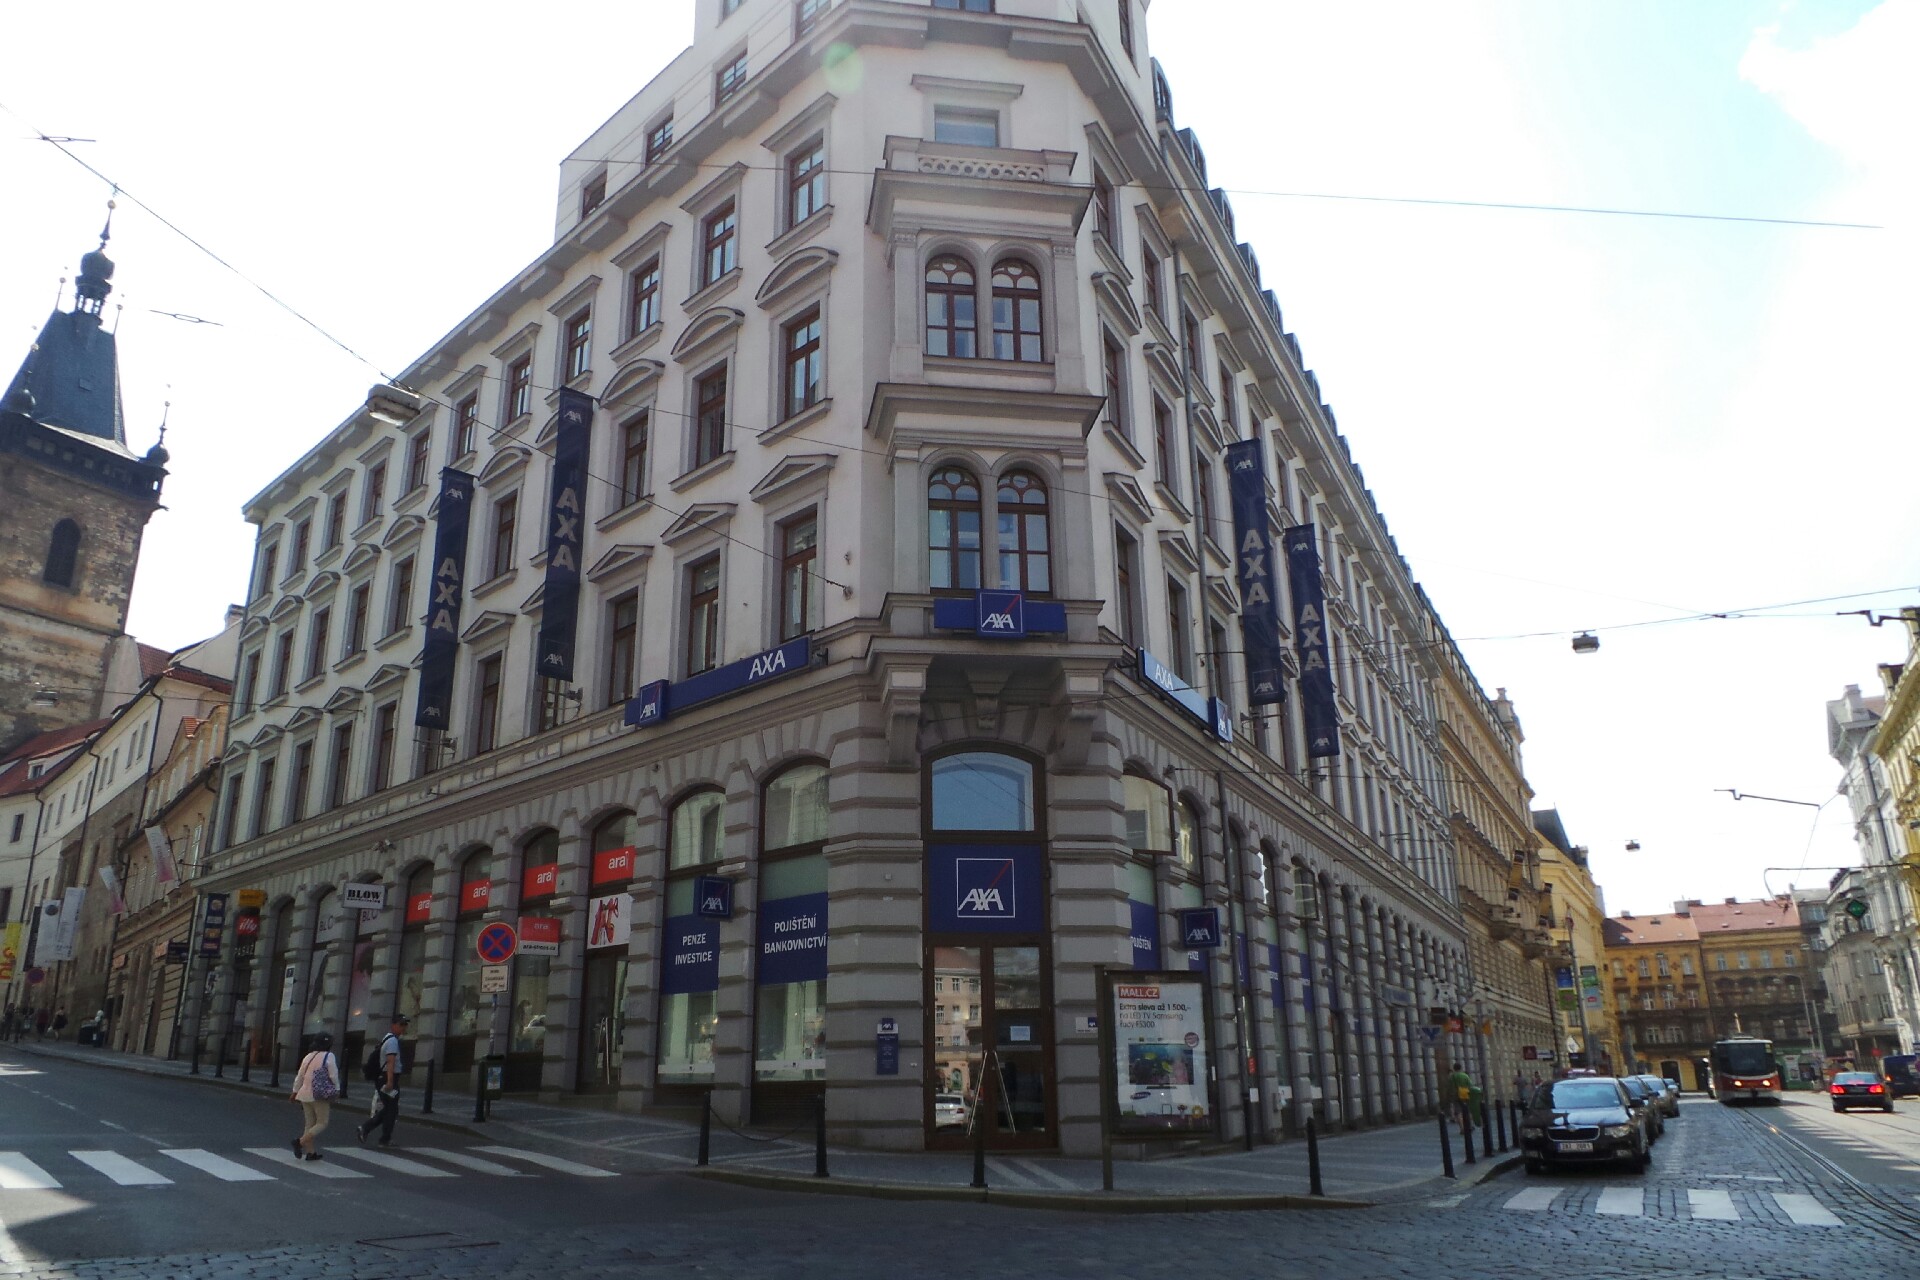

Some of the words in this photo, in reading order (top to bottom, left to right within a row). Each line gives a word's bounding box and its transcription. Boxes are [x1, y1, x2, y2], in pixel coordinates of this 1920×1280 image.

[564, 409, 582, 424] AXA
[1234, 458, 1254, 472] AXA
[446, 486, 464, 500] AXA
[551, 487, 581, 572] AXA
[1291, 541, 1309, 553] AXA
[1241, 529, 1270, 606] AXA
[432, 557, 460, 634] AXA
[981, 613, 1015, 630] AXA
[1299, 604, 1326, 671] AXA
[543, 652, 564, 666] AXA
[749, 649, 786, 681] AXA
[1155, 663, 1174, 691] AXA
[1253, 681, 1274, 694] AXA
[423, 705, 441, 717] AXA
[640, 702, 656, 720] AXA
[1312, 736, 1331, 748] AXA
[608, 855, 626, 869] ara
[537, 871, 552, 884] ara
[347, 889, 381, 900] BLOW
[473, 885, 487, 898] ara
[417, 898, 431, 911] ara
[702, 897, 724, 911] AXA
[958, 888, 1004, 911] AXA
[239, 918, 258, 933] illy
[774, 913, 817, 933] POJIŠTĚNÍ
[682, 933, 707, 946] PENZE
[1186, 928, 1210, 941] AXA
[764, 933, 828, 954] BANKOVNICTVÍ
[675, 950, 713, 965] INVESTICE
[1120, 987, 1159, 998] MALL.CZ
[1138, 1003, 1156, 1011] sleva
